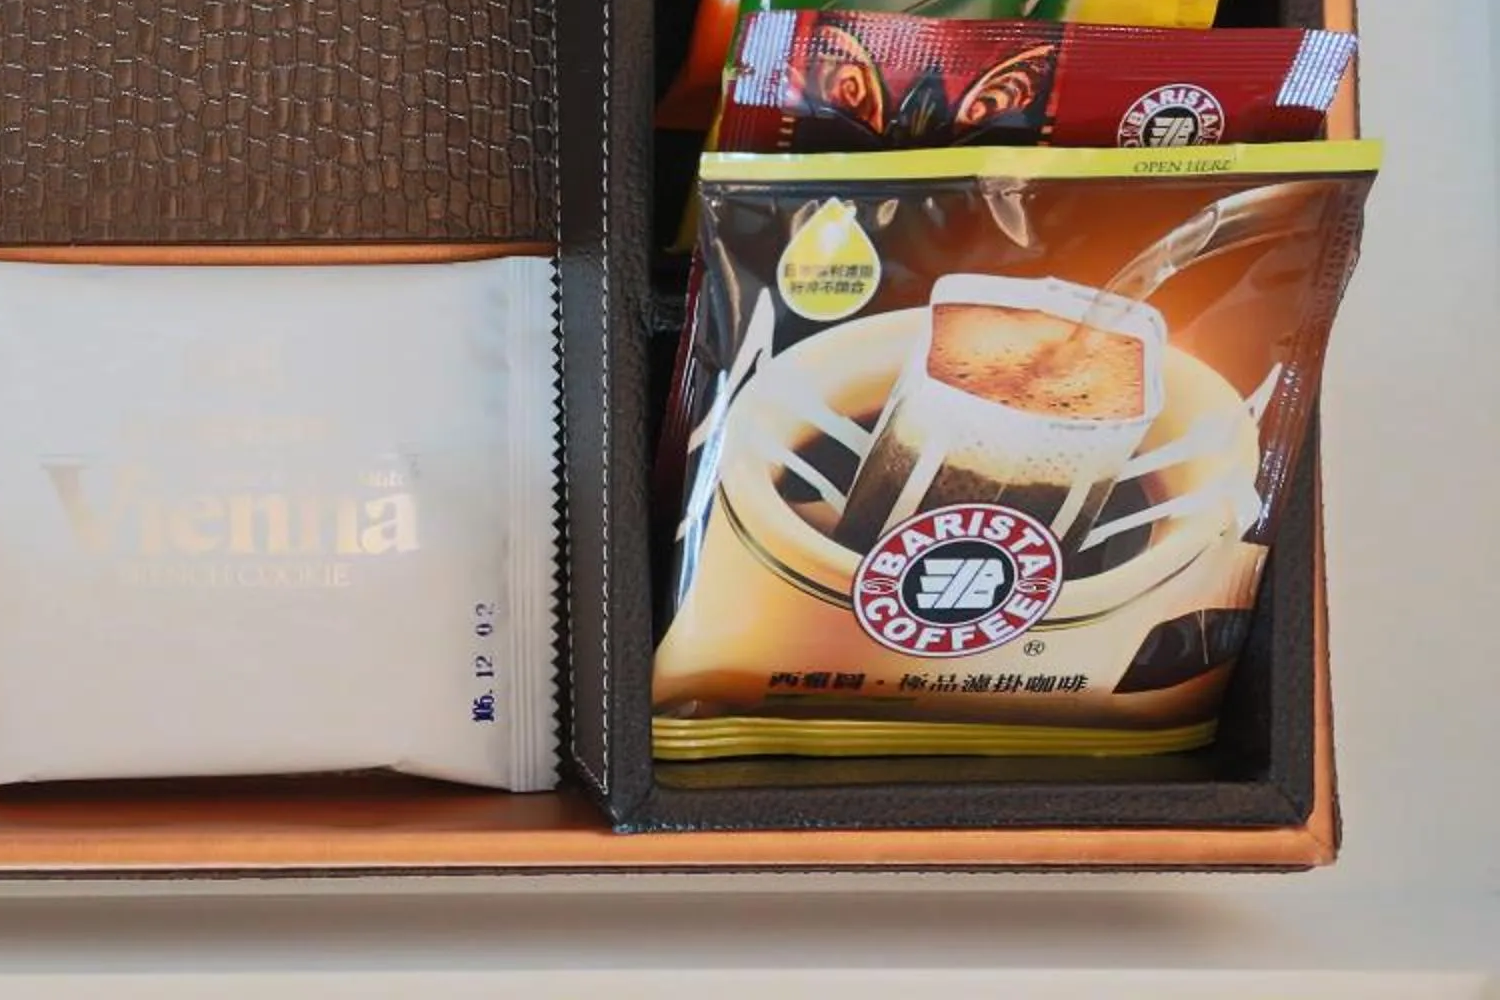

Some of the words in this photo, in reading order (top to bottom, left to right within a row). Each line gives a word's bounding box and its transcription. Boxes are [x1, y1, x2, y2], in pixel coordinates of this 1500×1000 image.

[1125, 87, 1220, 128] BARISTA
[1133, 160, 1181, 173] OPEN
[870, 510, 1051, 577] BARISTA
[864, 593, 1044, 650] COFFEE
